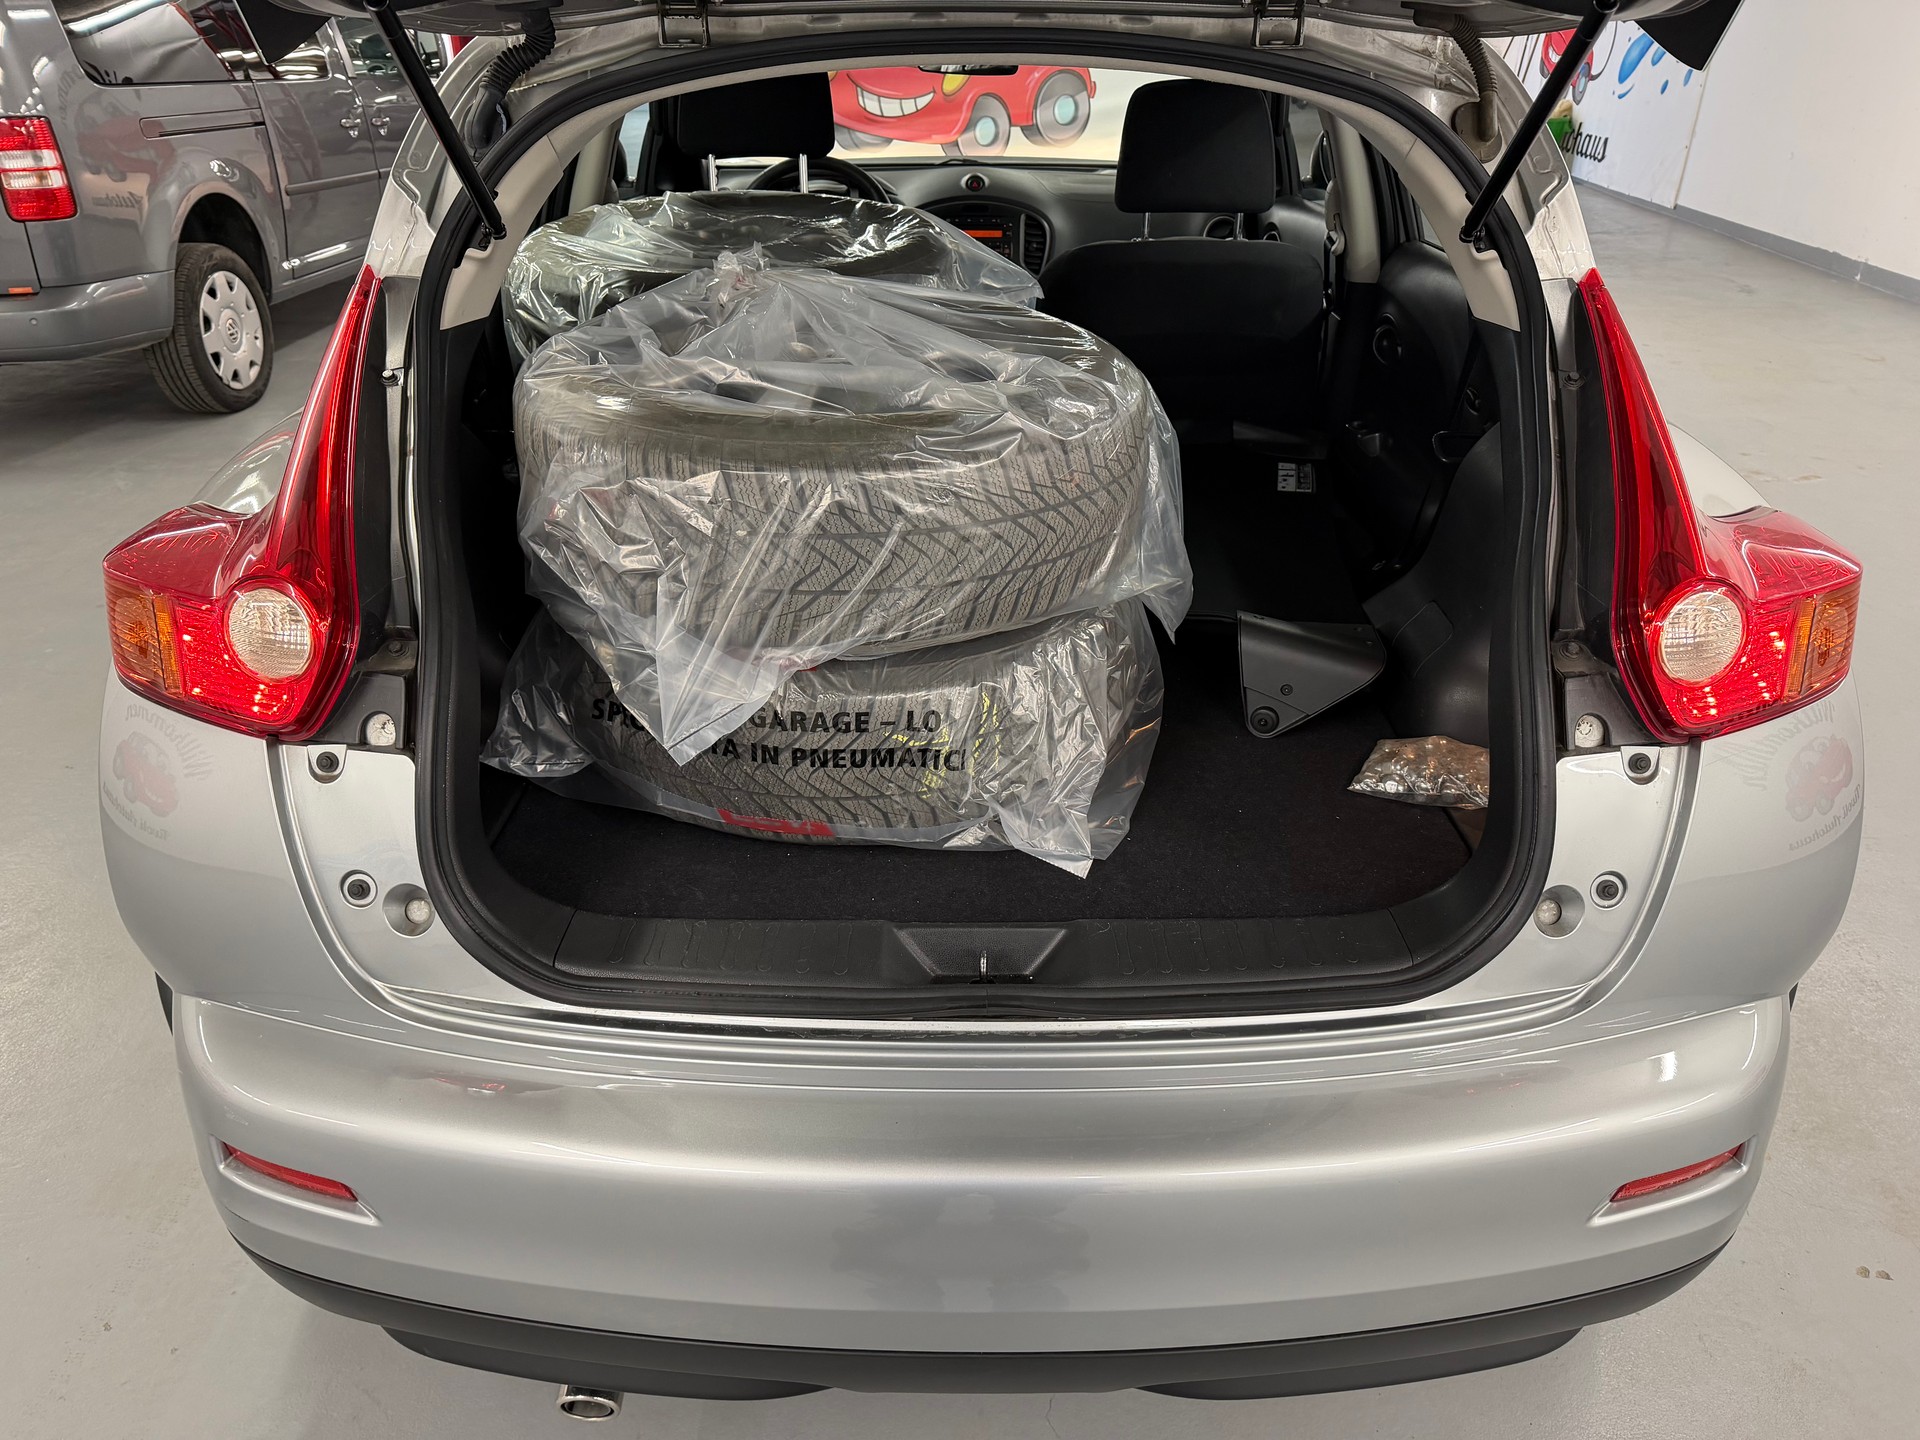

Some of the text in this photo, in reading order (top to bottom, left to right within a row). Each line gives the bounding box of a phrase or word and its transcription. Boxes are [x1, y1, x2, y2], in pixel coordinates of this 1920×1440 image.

[750, 707, 870, 733] GARAGE
[906, 710, 942, 733] LO
[751, 742, 779, 765] IN
[791, 747, 966, 772] PNEUMATICI
